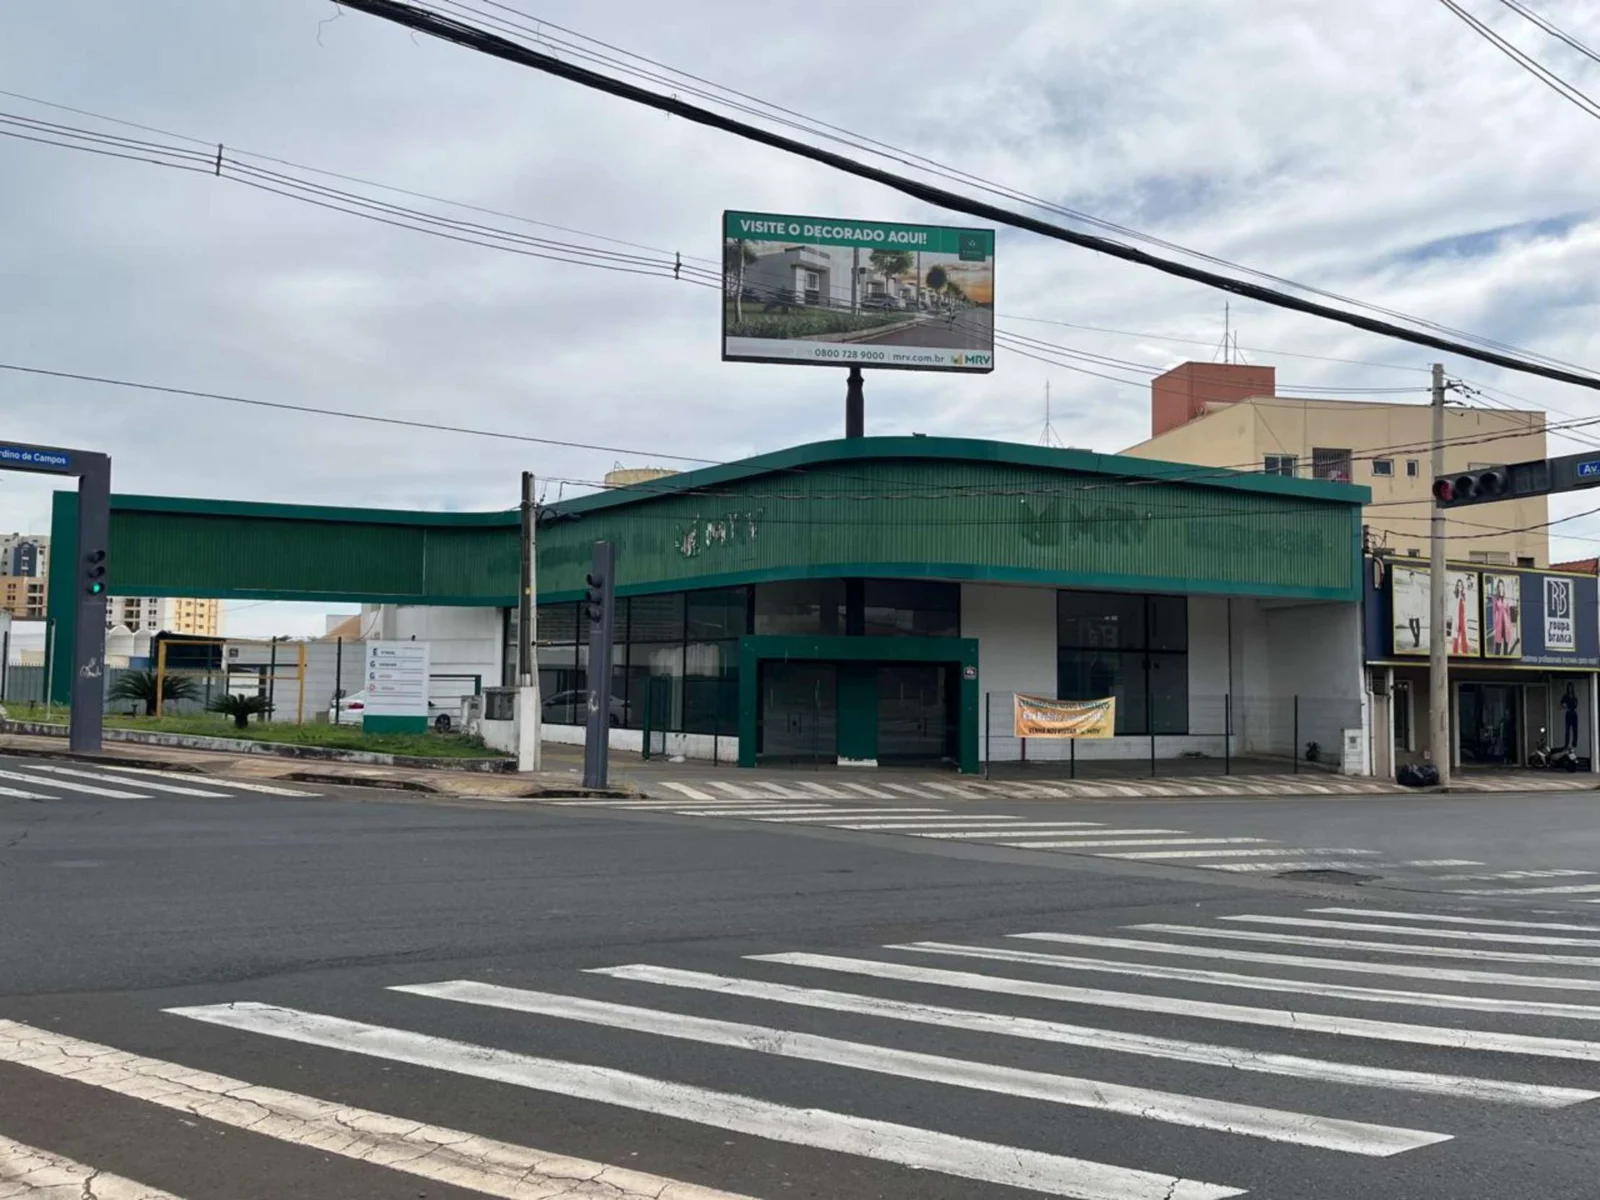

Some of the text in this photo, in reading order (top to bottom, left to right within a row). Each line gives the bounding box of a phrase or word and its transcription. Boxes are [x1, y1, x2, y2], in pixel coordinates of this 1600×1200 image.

[740, 219, 928, 245] VISITE O DECORADO AQUI!
[814, 348, 885, 361] 0800 728 9000
[892, 353, 945, 363] mrv.com.br
[964, 354, 991, 366] MRV
[21, 452, 32, 461] de
[33, 453, 66, 465] Campos
[1549, 621, 1570, 632] roupa
[1548, 632, 1572, 643] branca
